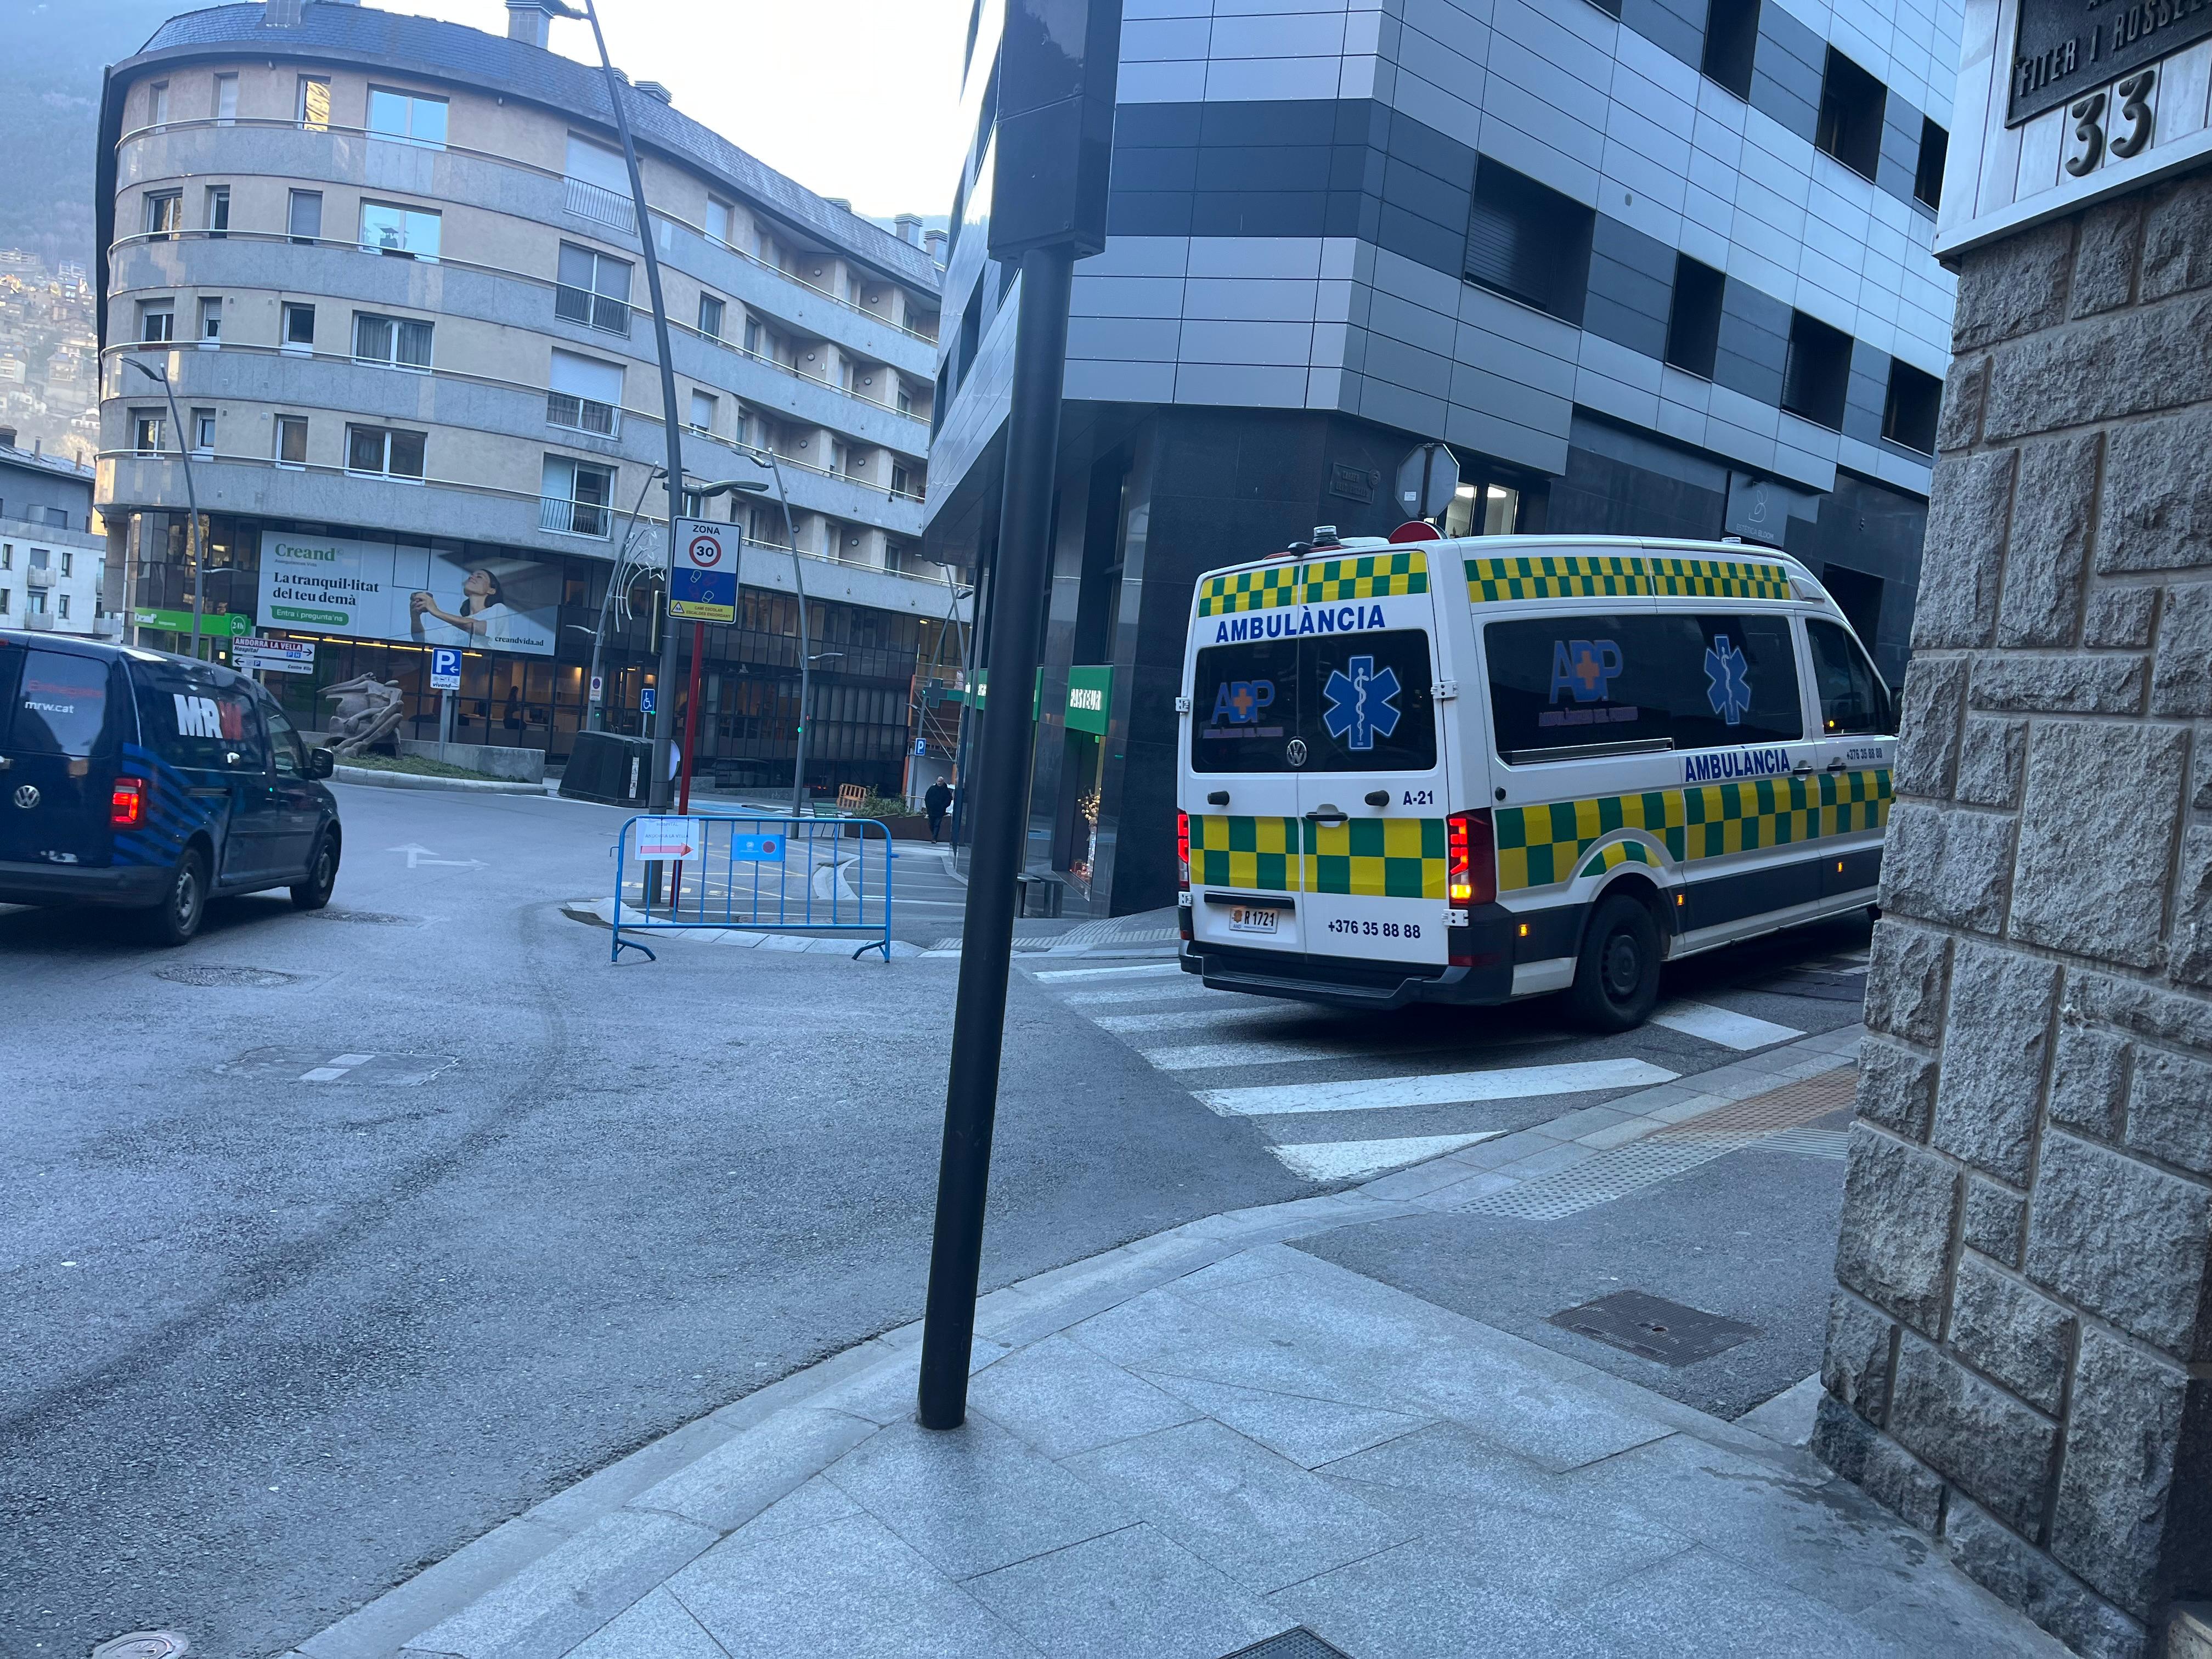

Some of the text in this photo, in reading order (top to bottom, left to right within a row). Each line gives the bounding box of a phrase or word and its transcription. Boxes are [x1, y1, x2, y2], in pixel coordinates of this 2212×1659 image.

[2019, 38, 2077, 97] FITER
[2090, 25, 2098, 64] I
[2065, 70, 2154, 177] 33
[693, 524, 720, 535] ZONA
[696, 546, 714, 557] 30
[274, 572, 379, 592] La tranquil·litat
[273, 587, 356, 606] del teu demà
[276, 609, 295, 618] Entra
[232, 622, 244, 630] 24h
[1216, 605, 1385, 643] AMBULÀNCIA
[235, 638, 269, 648] ANDORRA
[280, 643, 301, 651] VELLA
[495, 636, 544, 646] creandvida.ad
[25, 701, 75, 713] mrw.cat
[1070, 689, 1102, 711] PASTEUR
[173, 693, 242, 741] MRW
[1685, 745, 1791, 782] AMBULÀNCIA
[1403, 791, 1434, 805] A-21
[1244, 911, 1275, 927] R 1721
[1328, 919, 1421, 939] +376 35 88 88
